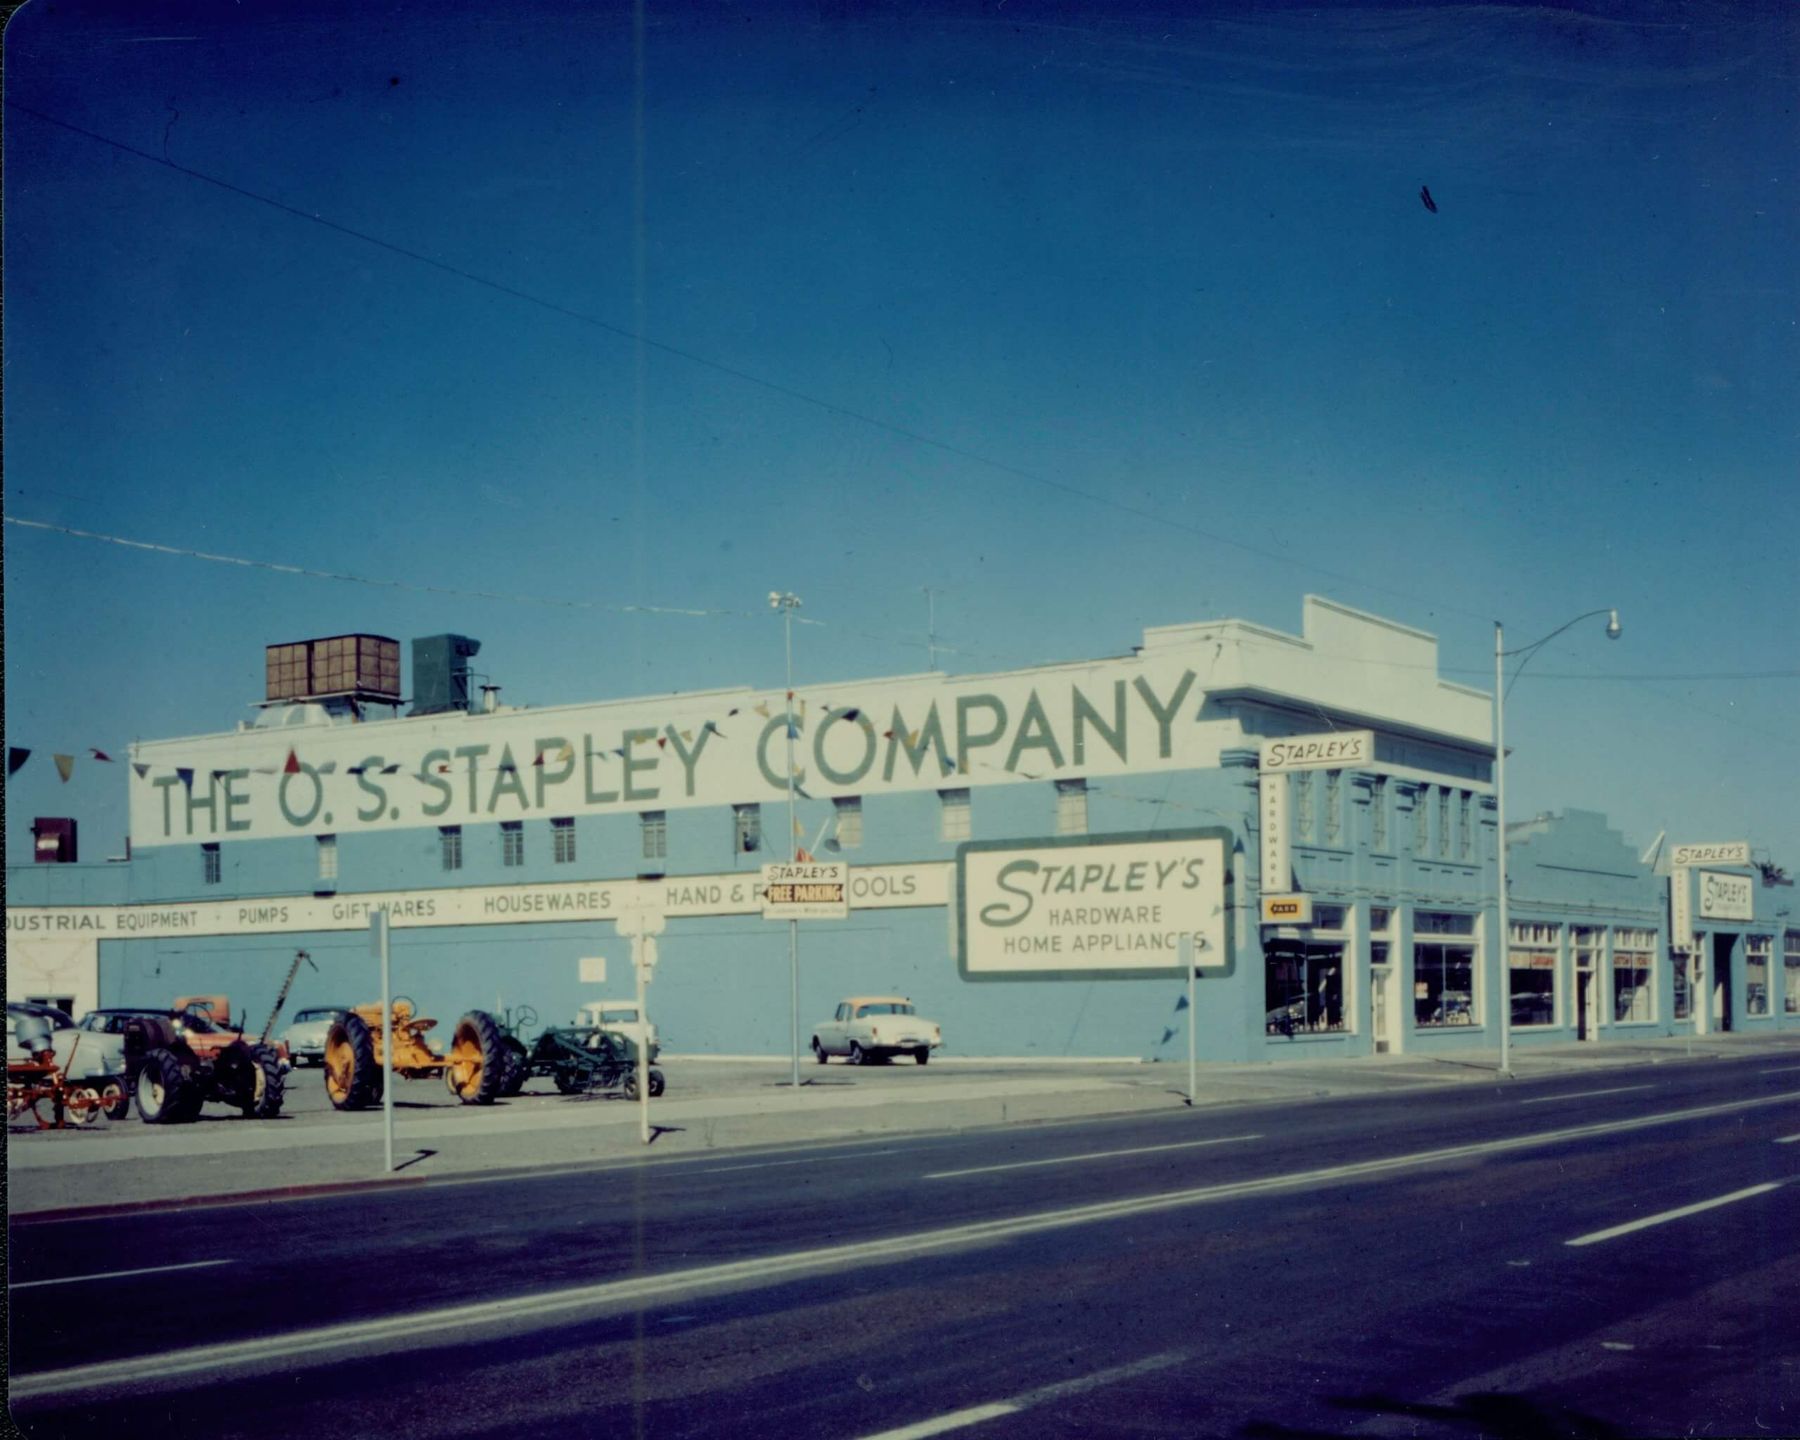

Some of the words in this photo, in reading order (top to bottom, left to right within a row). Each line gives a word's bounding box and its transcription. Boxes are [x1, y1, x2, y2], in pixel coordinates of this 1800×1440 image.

[152, 767, 252, 837] THE
[278, 761, 334, 827] O.
[357, 755, 400, 822] S.
[420, 719, 718, 817] STAPLEY
[755, 668, 1197, 791] COMPANY
[1266, 737, 1363, 767] STAPLEY'S
[1268, 782, 1279, 886] HARDWARE
[767, 865, 839, 881] STAPLEY'S
[666, 884, 721, 907] HAND
[730, 884, 744, 903] &
[768, 885, 793, 902] FREE
[794, 885, 841, 902] PARKING
[852, 875, 917, 898] OOLS
[979, 856, 1205, 928] STAPLEY'S
[484, 890, 612, 913] HOUSEWARES
[116, 910, 198, 931] EQUIPMENT
[239, 906, 289, 925] PUMPS
[1049, 905, 1163, 927] HARDWARE
[1003, 934, 1063, 954] HOME
